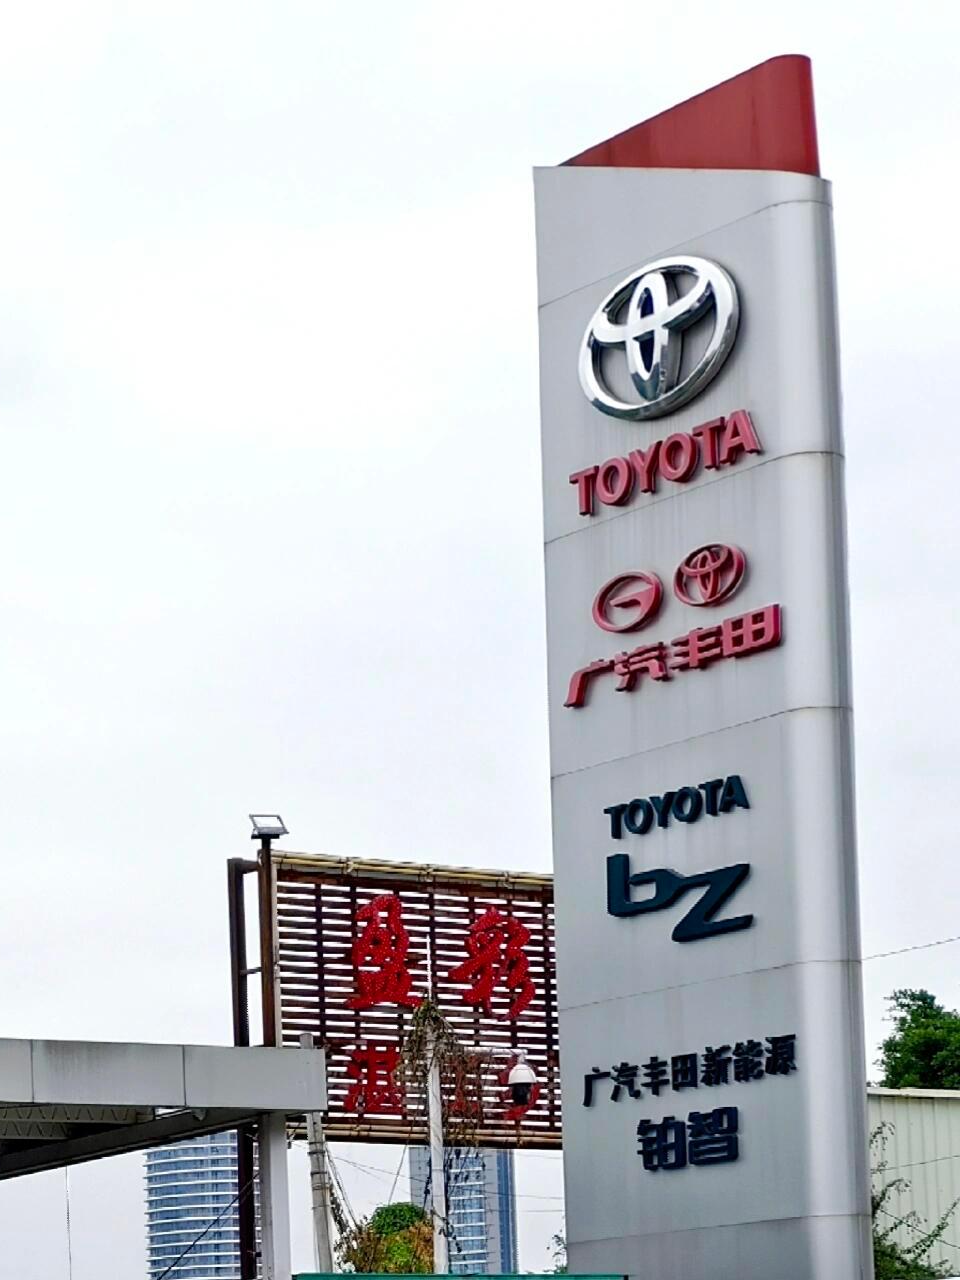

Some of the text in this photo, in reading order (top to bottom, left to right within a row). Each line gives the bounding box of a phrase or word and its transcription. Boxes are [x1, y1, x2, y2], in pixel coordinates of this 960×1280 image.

[569, 409, 761, 516] TOYOTA
[563, 603, 783, 708] 广汽丰田
[604, 775, 750, 839] TOYOTA
[583, 1034, 798, 1107] 广汽丰田新能源
[637, 1107, 740, 1171] 铂智
